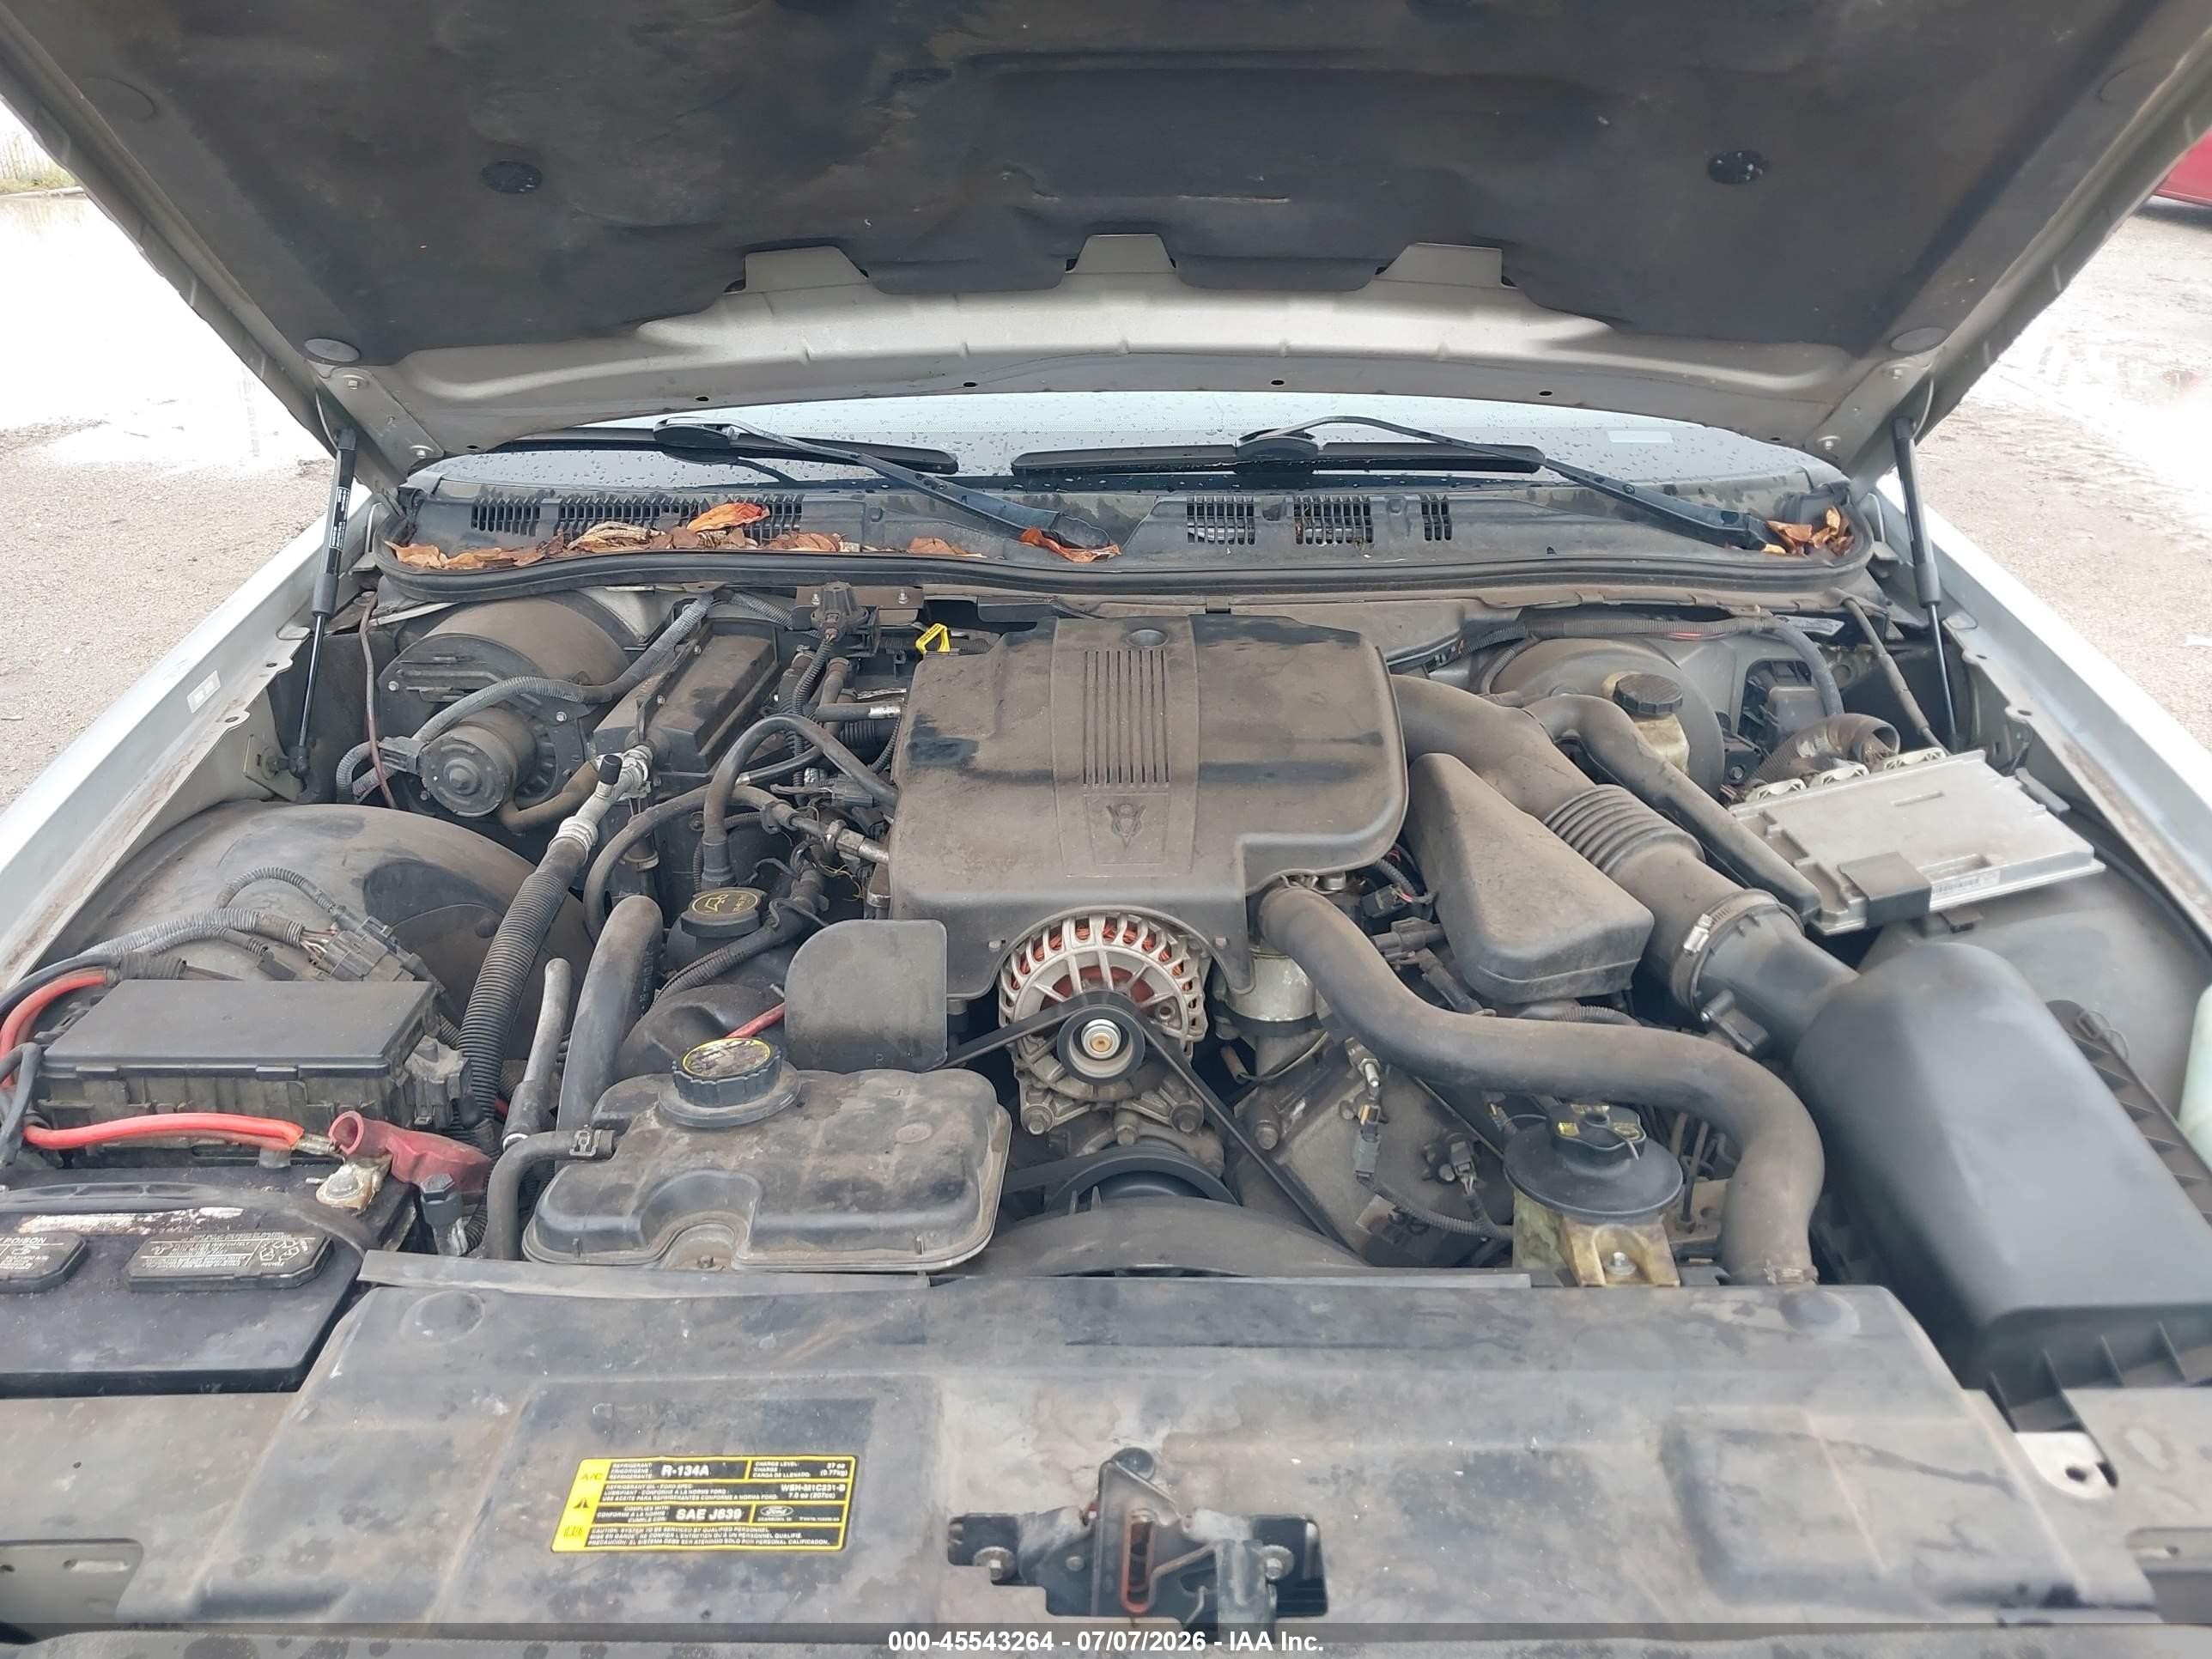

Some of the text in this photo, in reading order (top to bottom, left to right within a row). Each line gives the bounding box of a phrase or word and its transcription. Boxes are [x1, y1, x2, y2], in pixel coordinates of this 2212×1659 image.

[581, 1473, 604, 1481] A/C
[661, 1464, 708, 1477] R-134A
[675, 1508, 707, 1521] SAE
[708, 1508, 743, 1521] J639
